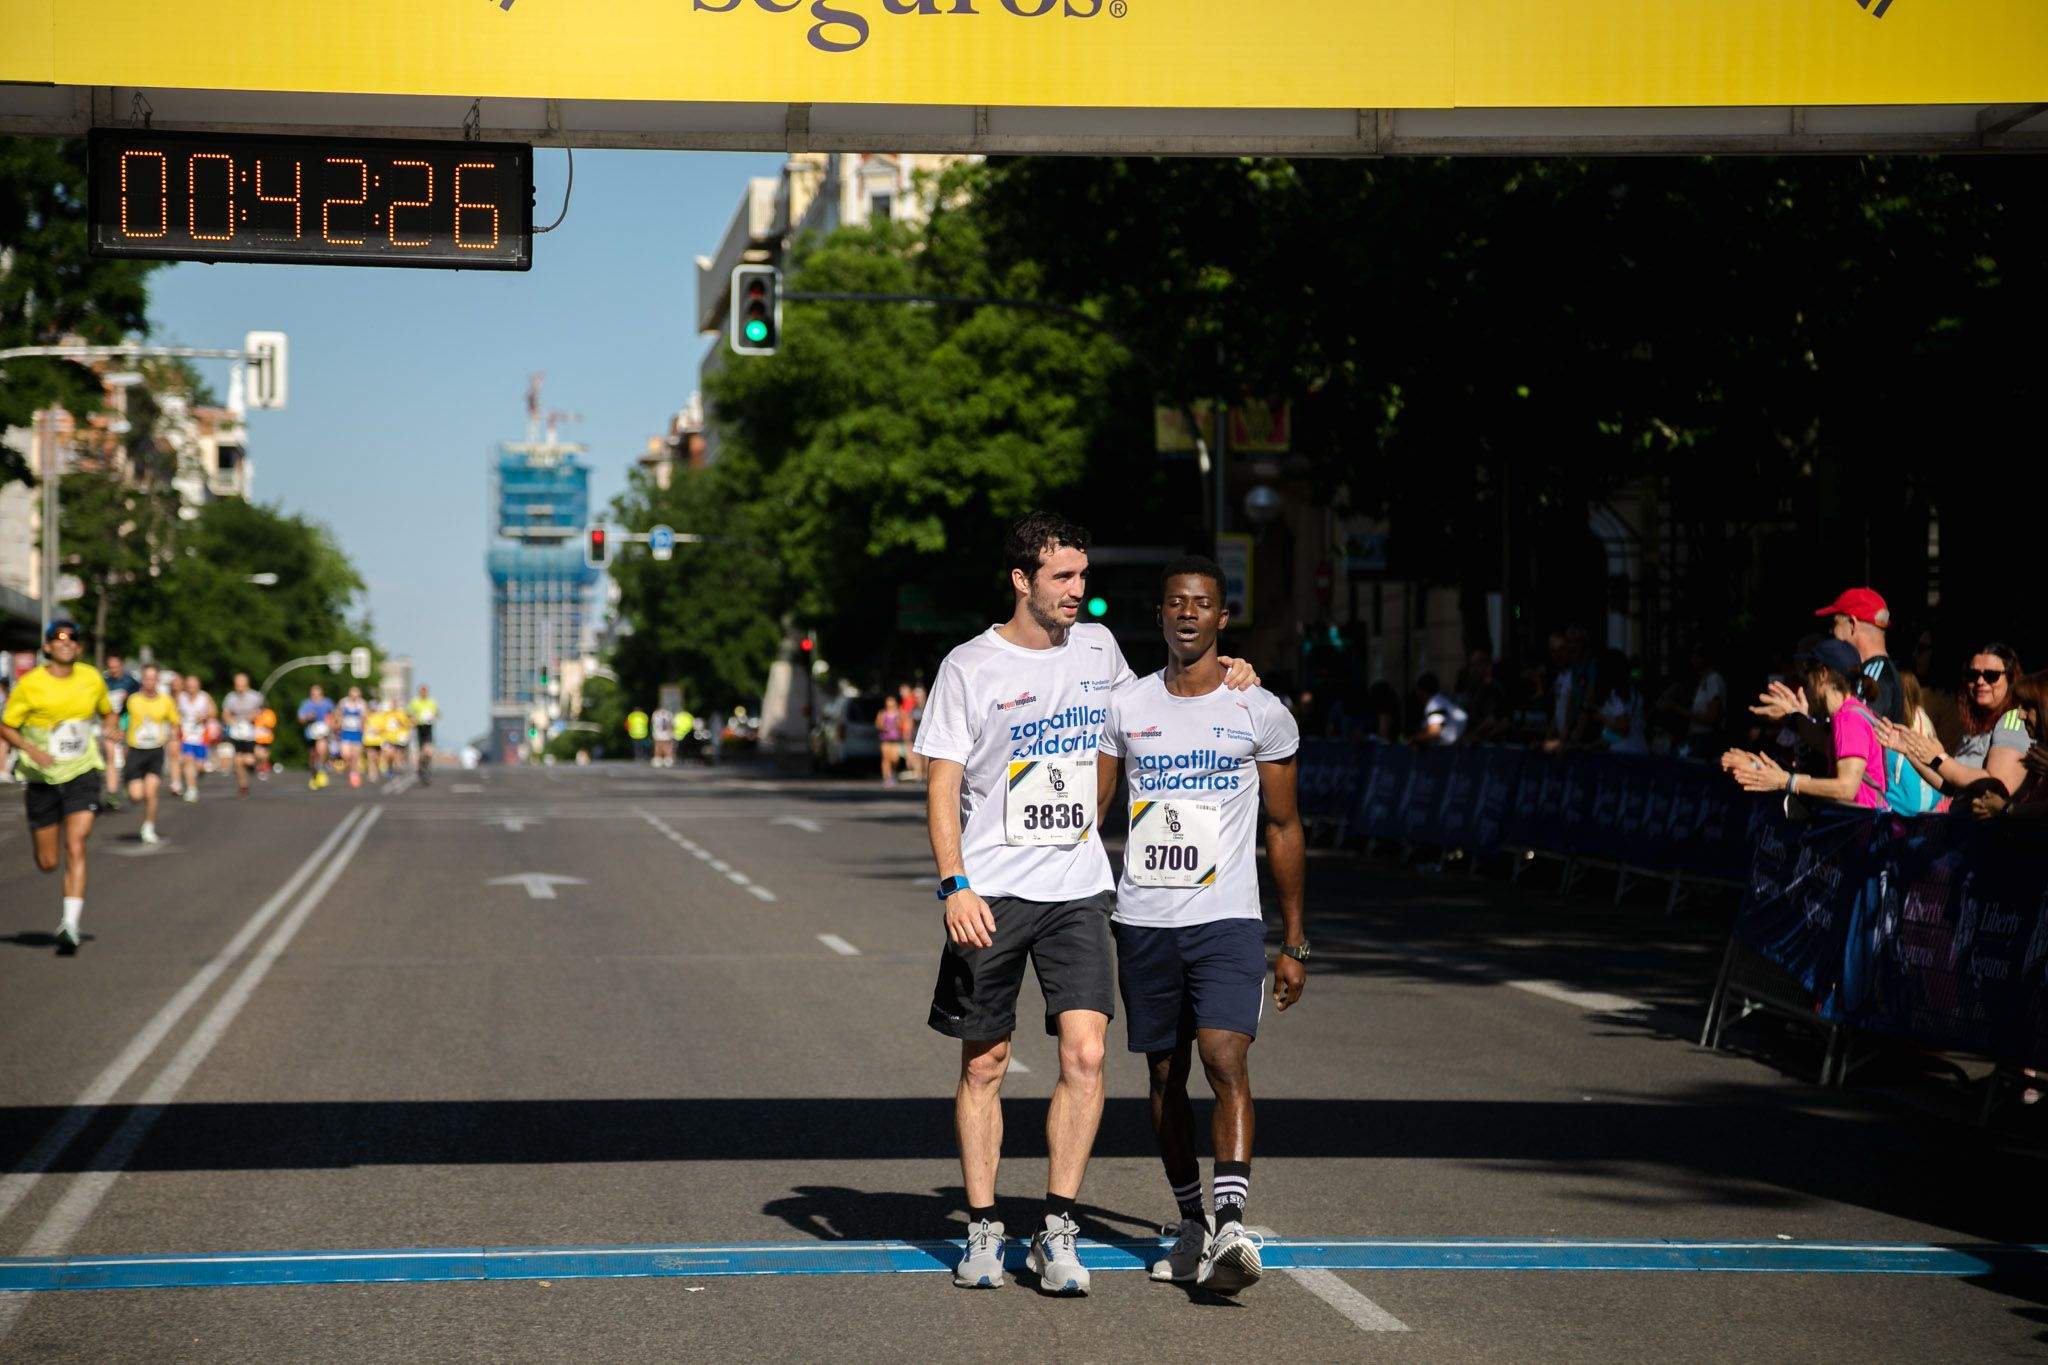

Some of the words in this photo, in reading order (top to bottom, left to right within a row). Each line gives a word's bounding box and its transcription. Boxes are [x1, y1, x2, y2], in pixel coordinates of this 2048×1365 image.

[121, 150, 499, 250] 00:42:26
[1010, 705, 1106, 741] zapatillas
[1024, 803, 1084, 830] 3836
[1145, 845, 1198, 871] 3700
